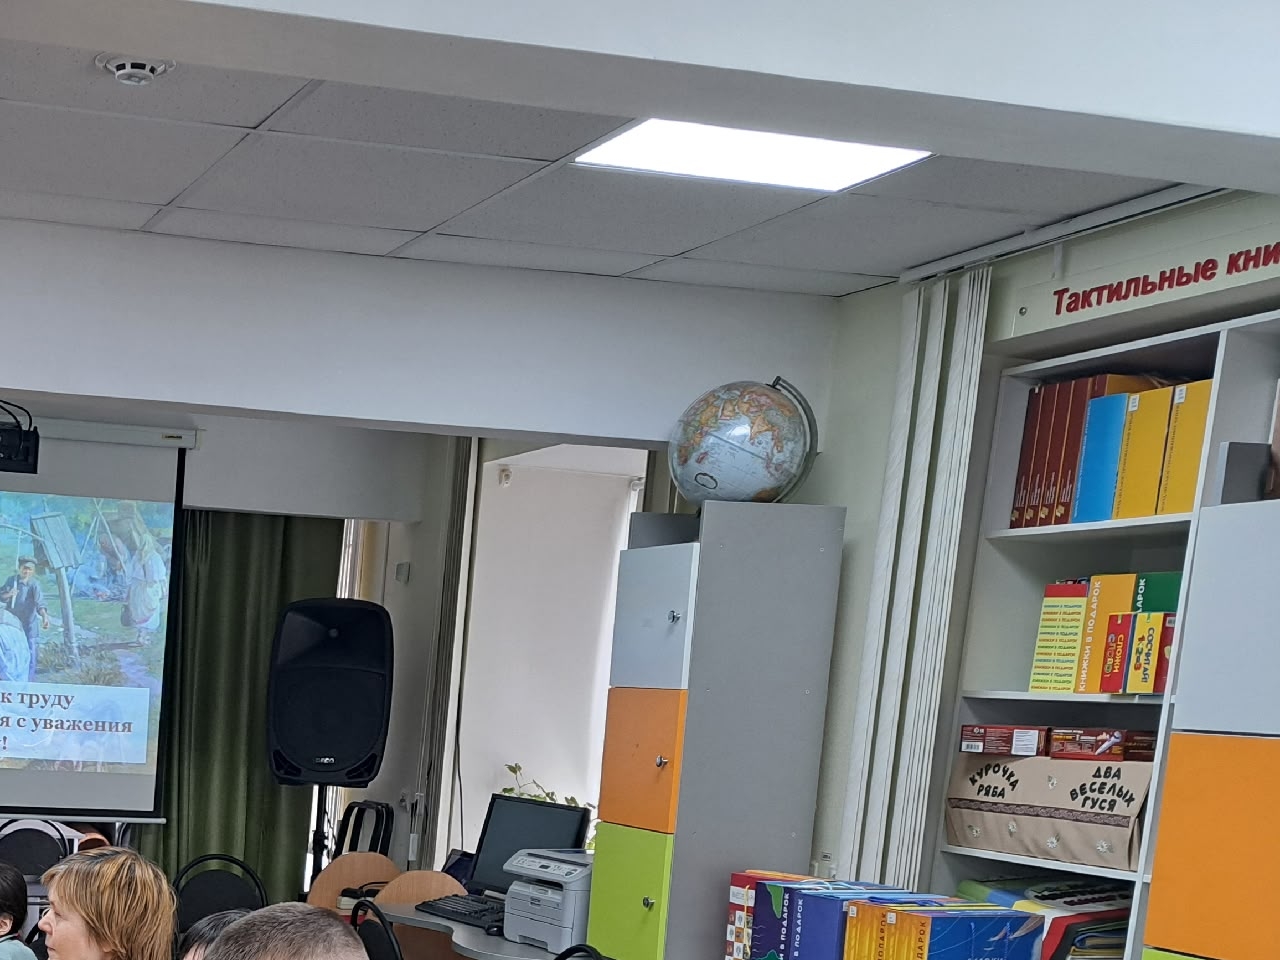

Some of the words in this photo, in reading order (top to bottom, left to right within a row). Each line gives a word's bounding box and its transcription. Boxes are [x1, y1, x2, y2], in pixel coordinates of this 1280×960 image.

[1053, 258, 1218, 315] Тактильные
[1136, 579, 1146, 614] АРОК
[1079, 646, 1091, 691] КНИЖКИ
[1087, 581, 1101, 633] ПОДАРОК
[0, 692, 12, 703] к
[17, 692, 75, 710] труду
[16, 716, 26, 728] с
[31, 717, 133, 733] уважения
[969, 763, 1019, 792] КУРОЧКА
[1092, 766, 1122, 780] ДВА
[977, 783, 1005, 799] РЯБА
[1070, 781, 1135, 808] ВЕСЕЛЫХ
[1081, 796, 1116, 812] ГУСЯ
[780, 893, 789, 941] ПОДАРОК
[795, 899, 803, 947] ПОДАРОК
